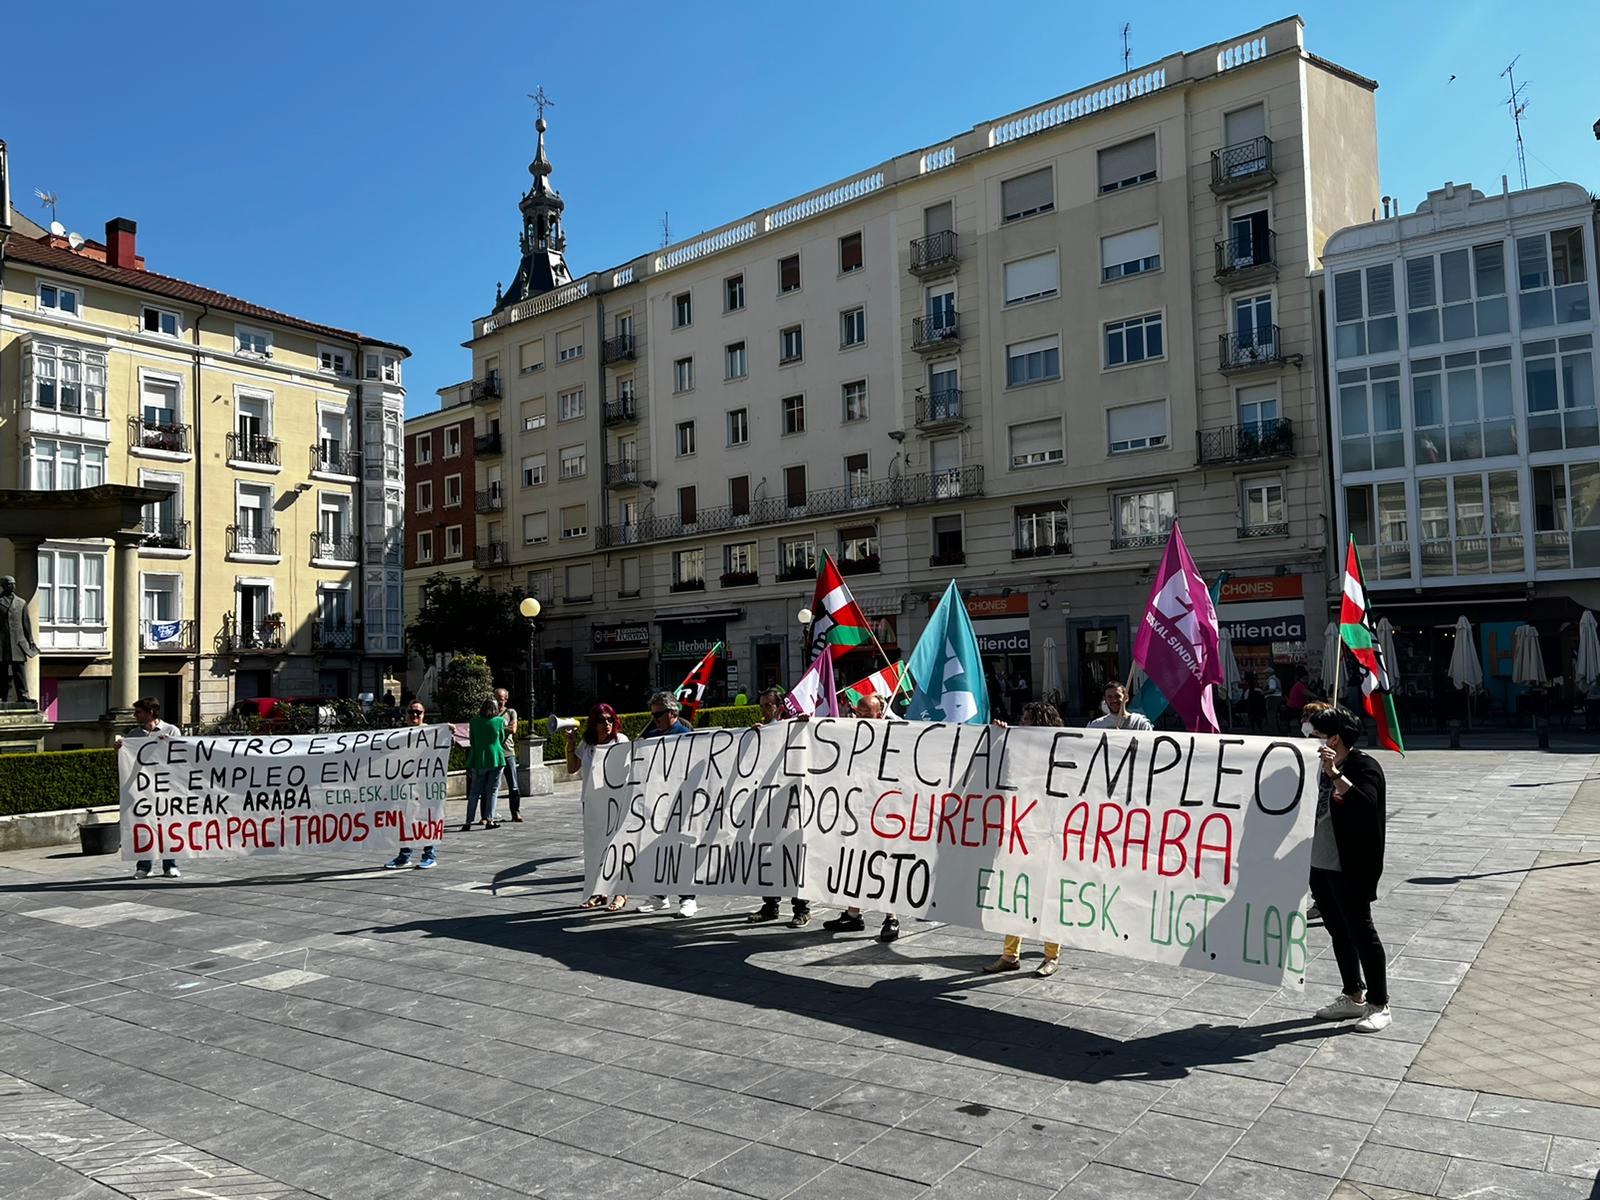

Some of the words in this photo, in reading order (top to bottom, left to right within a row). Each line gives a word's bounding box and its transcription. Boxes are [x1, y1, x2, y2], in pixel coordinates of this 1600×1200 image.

[1221, 582, 1274, 595] CHONES
[968, 599, 1008, 612] CHONES
[979, 635, 1029, 651] tienda
[1230, 621, 1302, 639] itienda
[1167, 636, 1203, 682] SINDIKA
[783, 697, 797, 716] EUS
[136, 737, 294, 766] CENTRO
[136, 771, 170, 792] DE
[188, 765, 306, 792] EMPLEO
[320, 761, 357, 784] EN
[367, 757, 446, 781] LUCHA
[603, 726, 762, 790] CENTRO
[1045, 731, 1306, 816] EMPLEO
[133, 794, 229, 818] GUREAK
[243, 784, 312, 812] ARABA
[373, 810, 398, 828] EN
[870, 789, 1039, 856] GUREAK
[1062, 801, 1233, 886] ARABA
[654, 843, 683, 886] UN
[827, 846, 937, 909] JUSTO.
